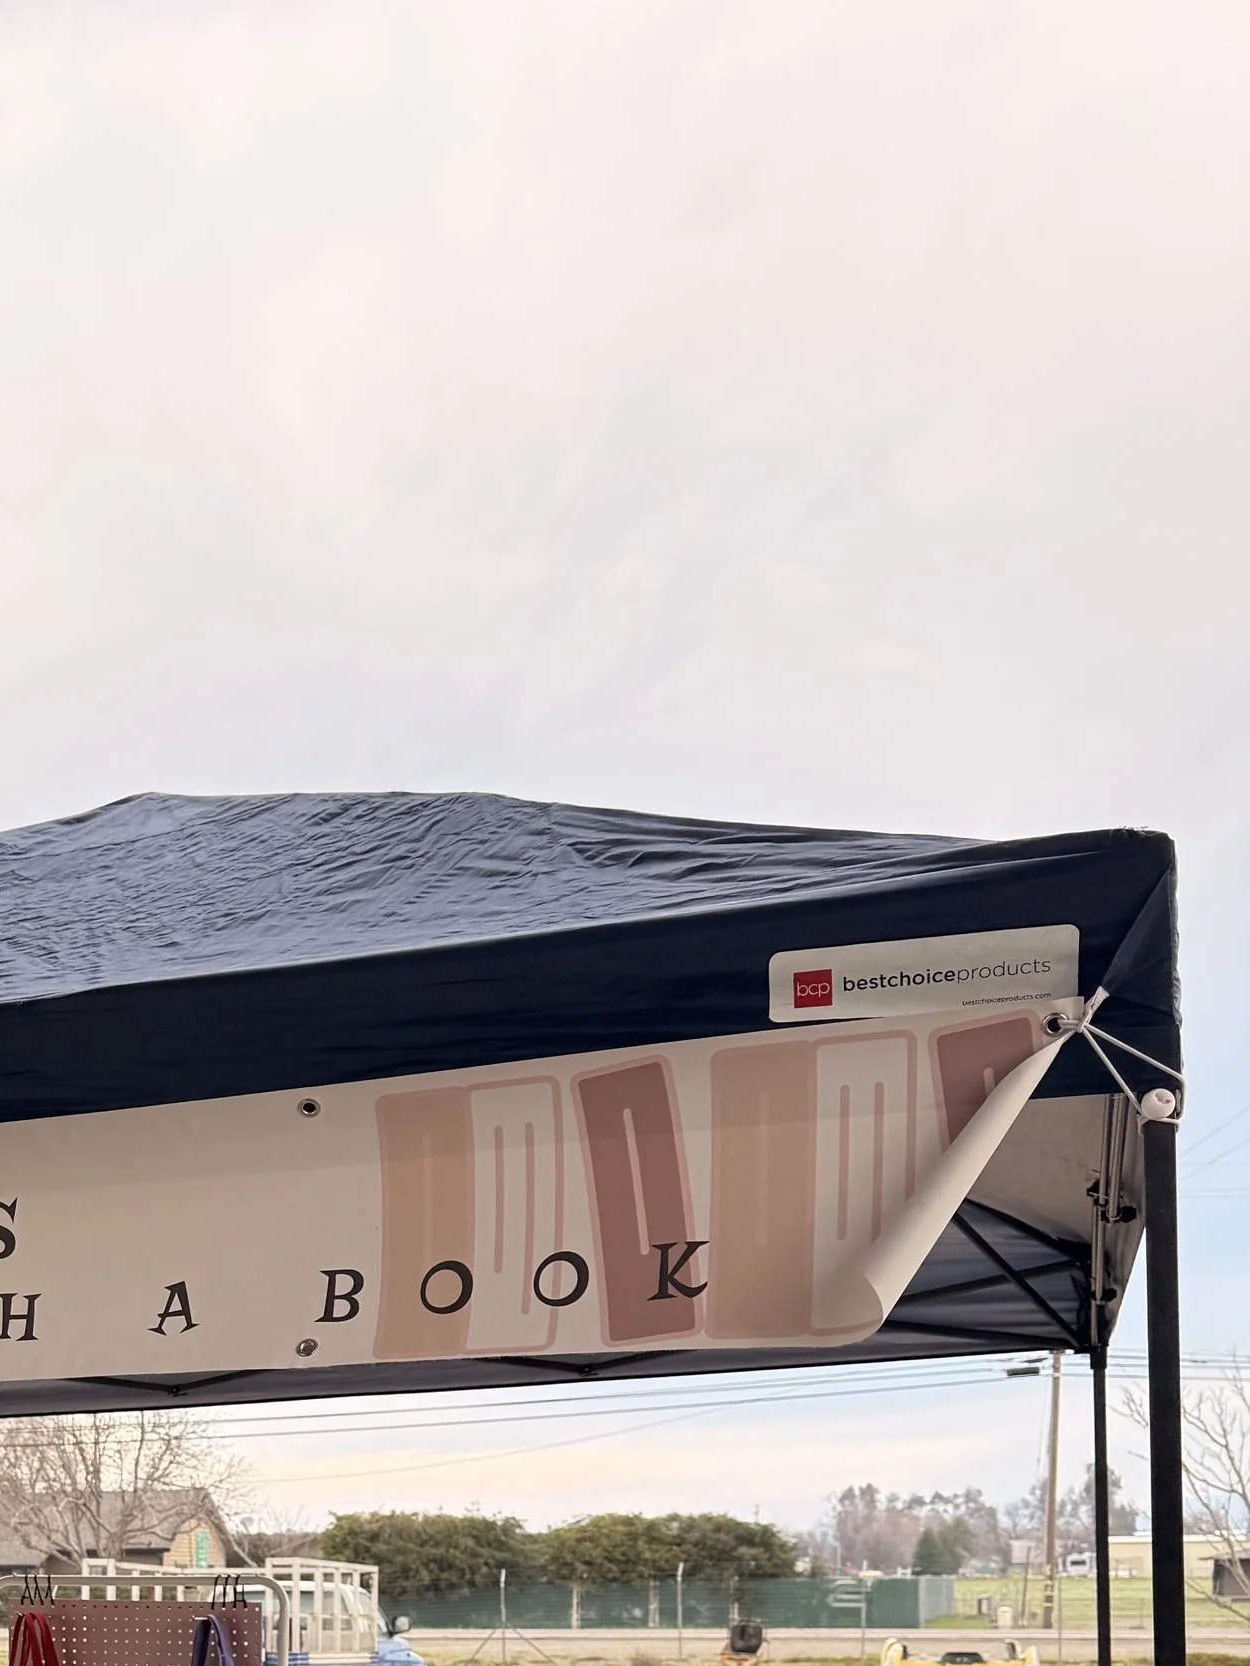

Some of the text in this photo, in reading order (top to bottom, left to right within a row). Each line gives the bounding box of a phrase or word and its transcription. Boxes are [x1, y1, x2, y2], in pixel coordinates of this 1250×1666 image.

[843, 958, 1051, 992] bestchoiceproducts
[797, 981, 830, 998] bcp
[962, 991, 1052, 1007] bestchoiceproducts.com
[147, 1280, 200, 1336] A
[314, 1240, 710, 1323] BOOK
